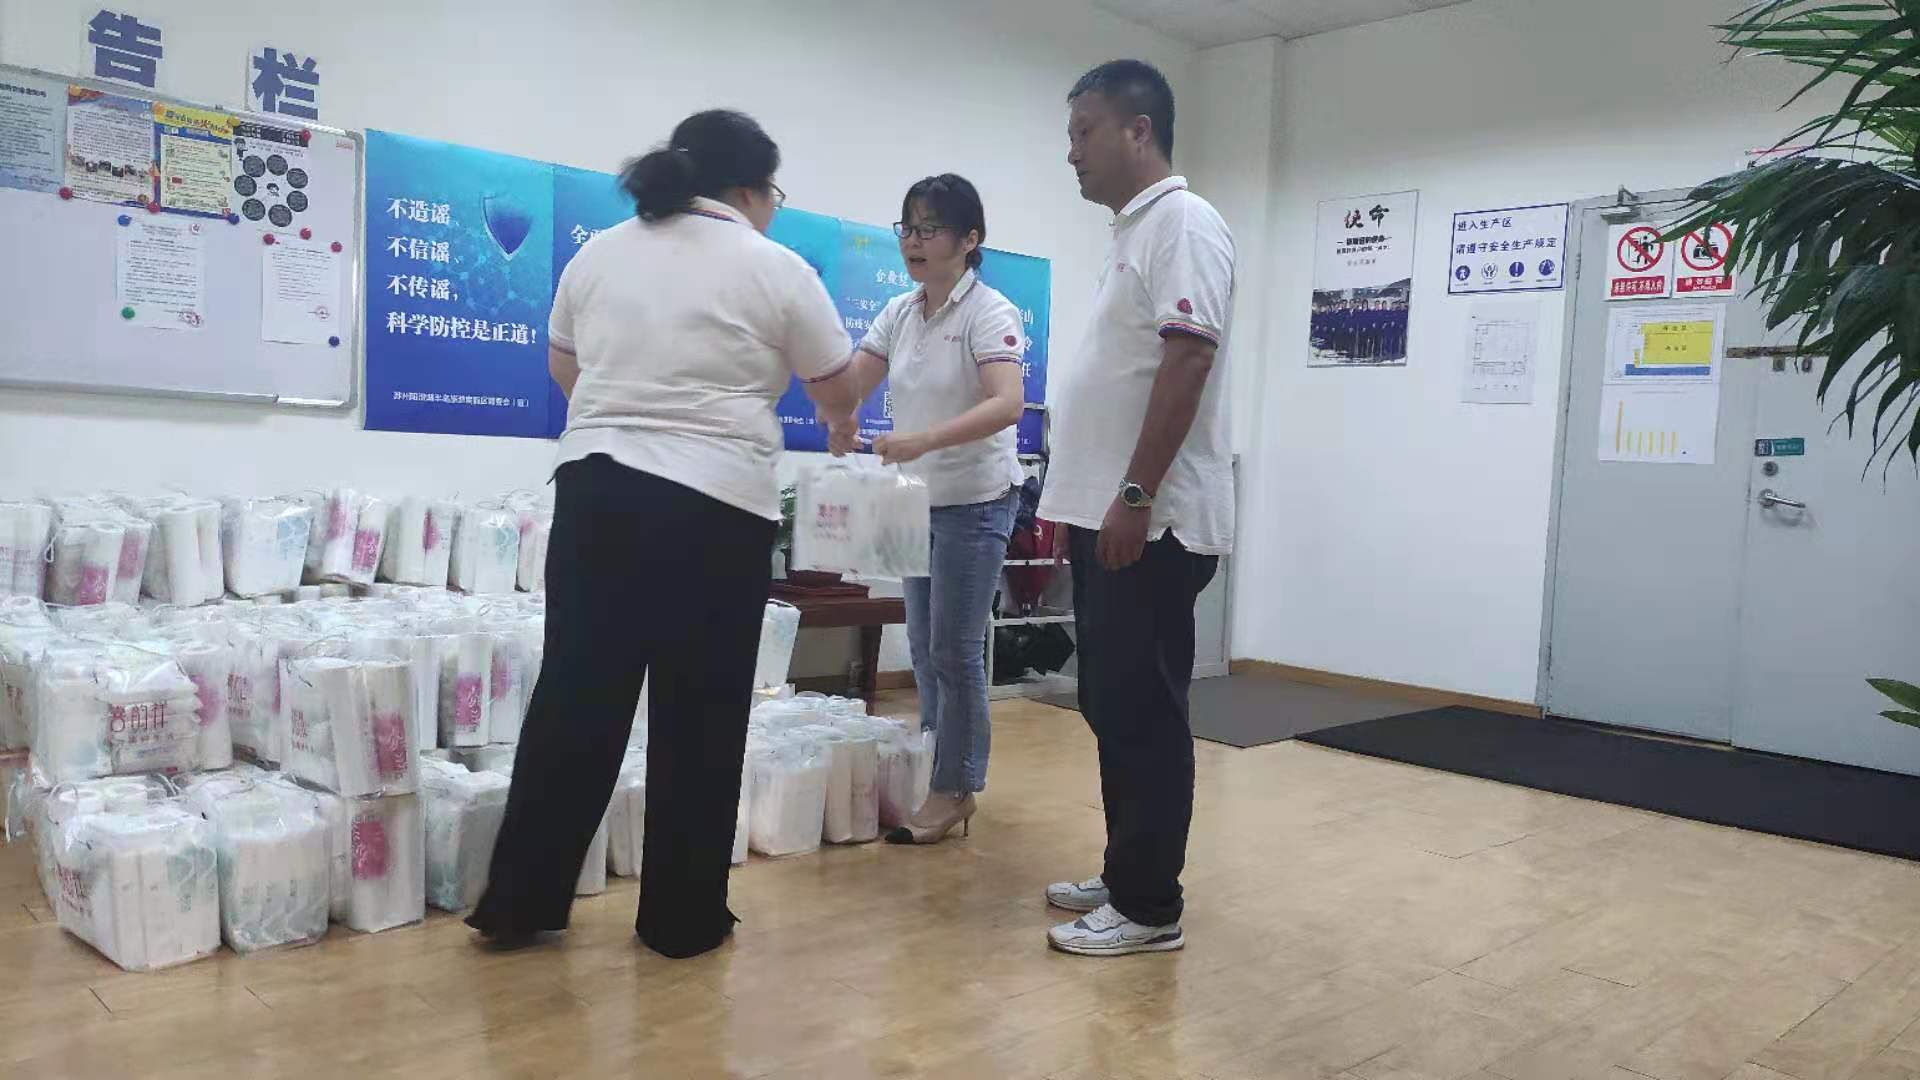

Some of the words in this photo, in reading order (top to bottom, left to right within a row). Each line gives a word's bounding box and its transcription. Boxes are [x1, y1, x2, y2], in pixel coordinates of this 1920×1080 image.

[88, 9, 163, 88] 告
[252, 47, 320, 120] 栏
[386, 196, 460, 226] 不造谣、
[1457, 216, 1512, 231] 进入生产区
[386, 236, 460, 264] 不信谣、
[1456, 237, 1558, 255] 请遵守安全生产规定
